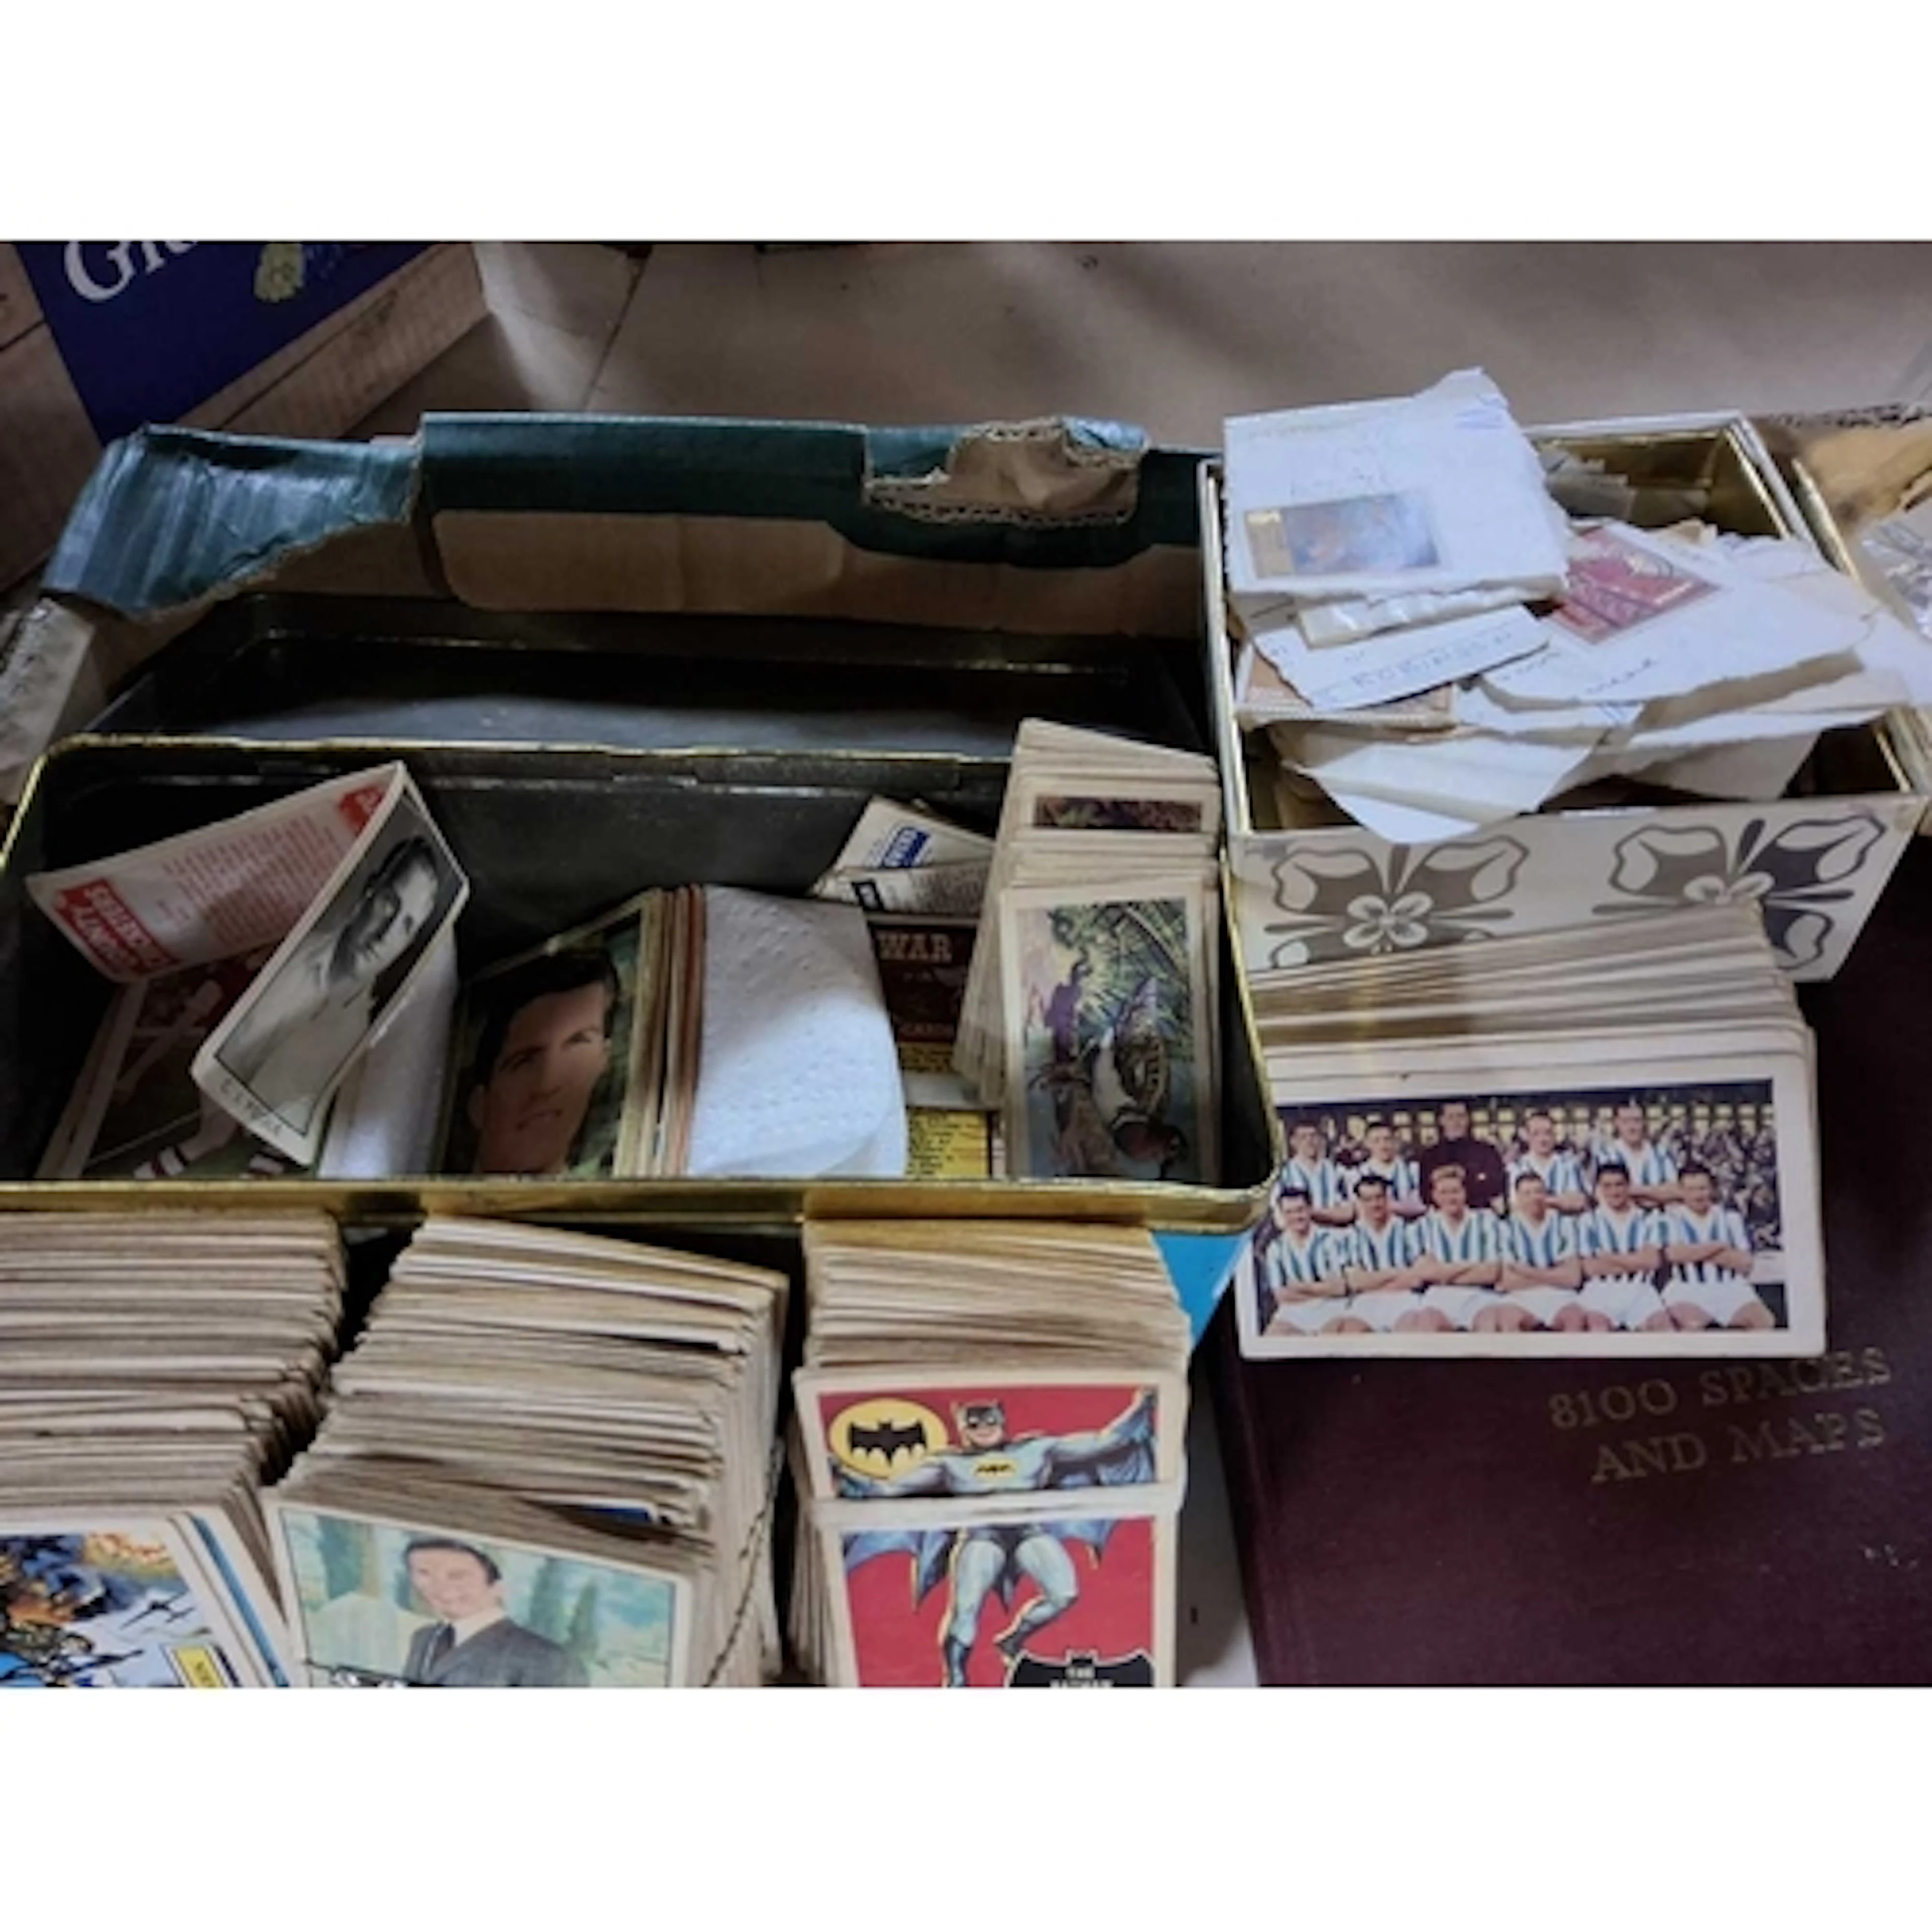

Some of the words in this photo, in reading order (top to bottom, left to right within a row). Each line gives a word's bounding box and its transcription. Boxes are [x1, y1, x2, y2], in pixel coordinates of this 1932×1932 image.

[876, 932, 953, 964] WAR
[1548, 1378, 1677, 1430] 8100
[1699, 1344, 1892, 1407] SPACES
[1590, 1431, 1708, 1484] AND
[1728, 1408, 1887, 1464] MAPS
